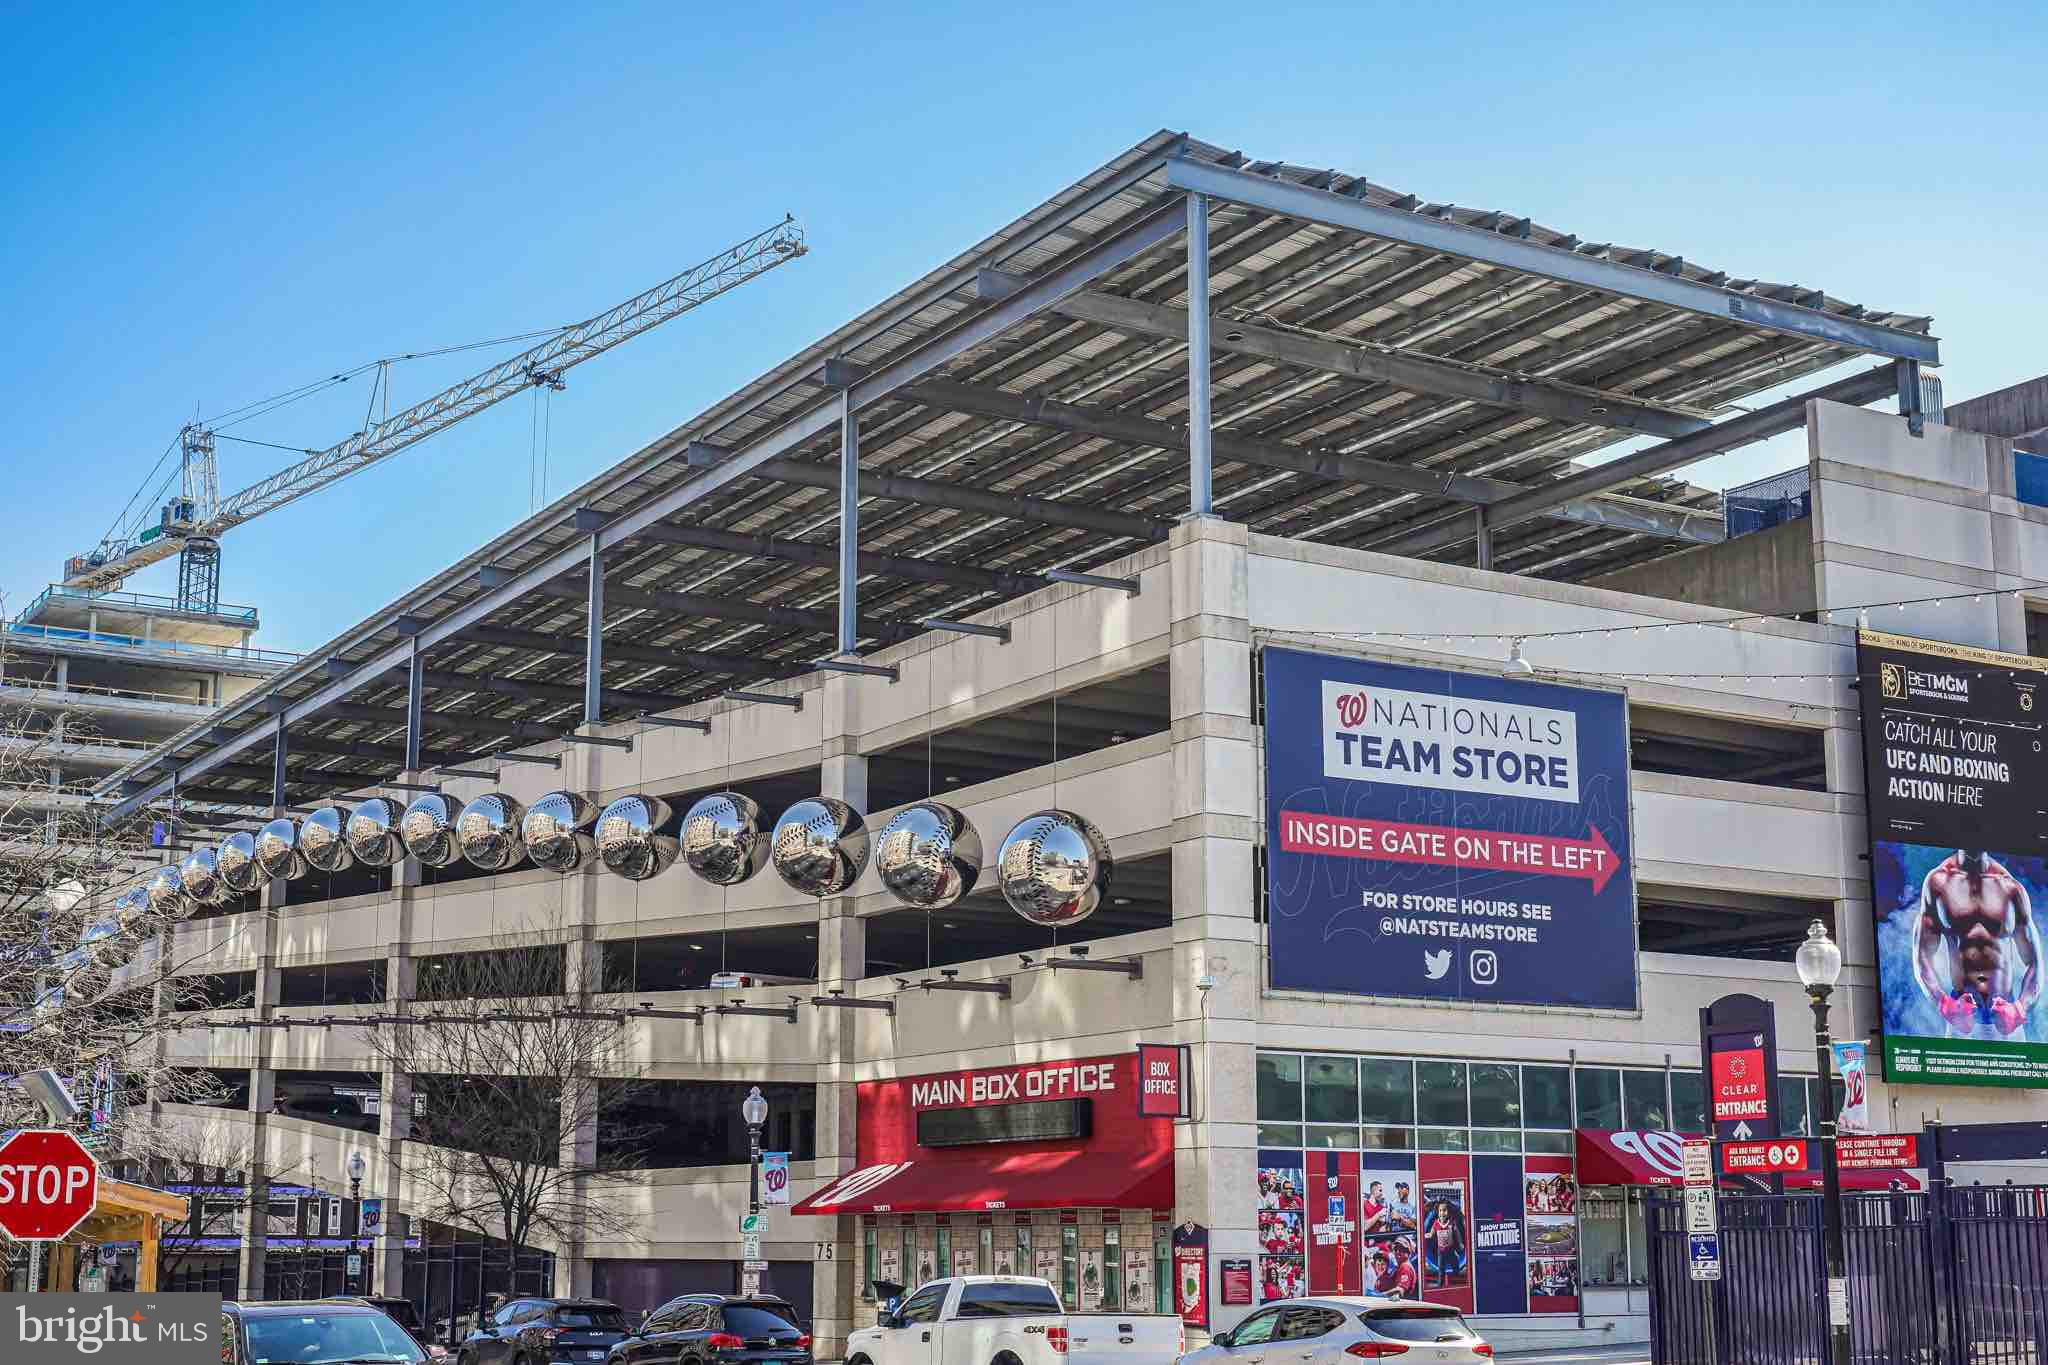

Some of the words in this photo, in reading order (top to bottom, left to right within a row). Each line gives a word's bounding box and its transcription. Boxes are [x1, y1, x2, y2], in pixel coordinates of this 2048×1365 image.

[1907, 671, 1968, 694] BETMGM
[1373, 698, 1562, 745] NATIONALS
[1885, 720, 1931, 745] CATCH
[1933, 727, 1957, 749] ALL
[1960, 730, 1997, 754] YOUR
[1335, 731, 1441, 775] TEAM
[1452, 745, 1569, 789] STORE
[1886, 748, 1917, 771] UFC
[1919, 753, 1952, 775] AND
[1953, 757, 2010, 783] BOXING
[1888, 777, 1945, 802] ACTION
[1947, 784, 1984, 807] HERE
[1287, 820, 1373, 851] INSIDE
[1381, 830, 1446, 858] GATE
[1454, 836, 1490, 861] ON
[1498, 840, 1544, 866] THE
[1551, 846, 1607, 872] LEFT
[1362, 890, 1398, 910] FOR
[1401, 893, 1457, 914] STORE
[1461, 898, 1518, 919] HOURS
[1521, 904, 1552, 921] SEE
[1379, 917, 1538, 944] @NATSTEAMSTORE
[1150, 1061, 1170, 1077] BOX
[912, 1079, 965, 1107] MAIN
[971, 1072, 1022, 1102] BOX
[1026, 1063, 1116, 1097] OFFICE
[1144, 1079, 1177, 1095] OFFICE
[1721, 1083, 1759, 1096] CLEAR
[1715, 1100, 1768, 1116] ENTRANCE
[1729, 1154, 1767, 1167] ENTRANCE
[1854, 1149, 1873, 1157] SINGLE
[0, 1165, 89, 1204] STOP
[985, 1200, 1005, 1209] TICKETS
[1477, 1229, 1520, 1248] NATITUDE
[1480, 1223, 1499, 1231] SHOW
[816, 1243, 833, 1260] 75
